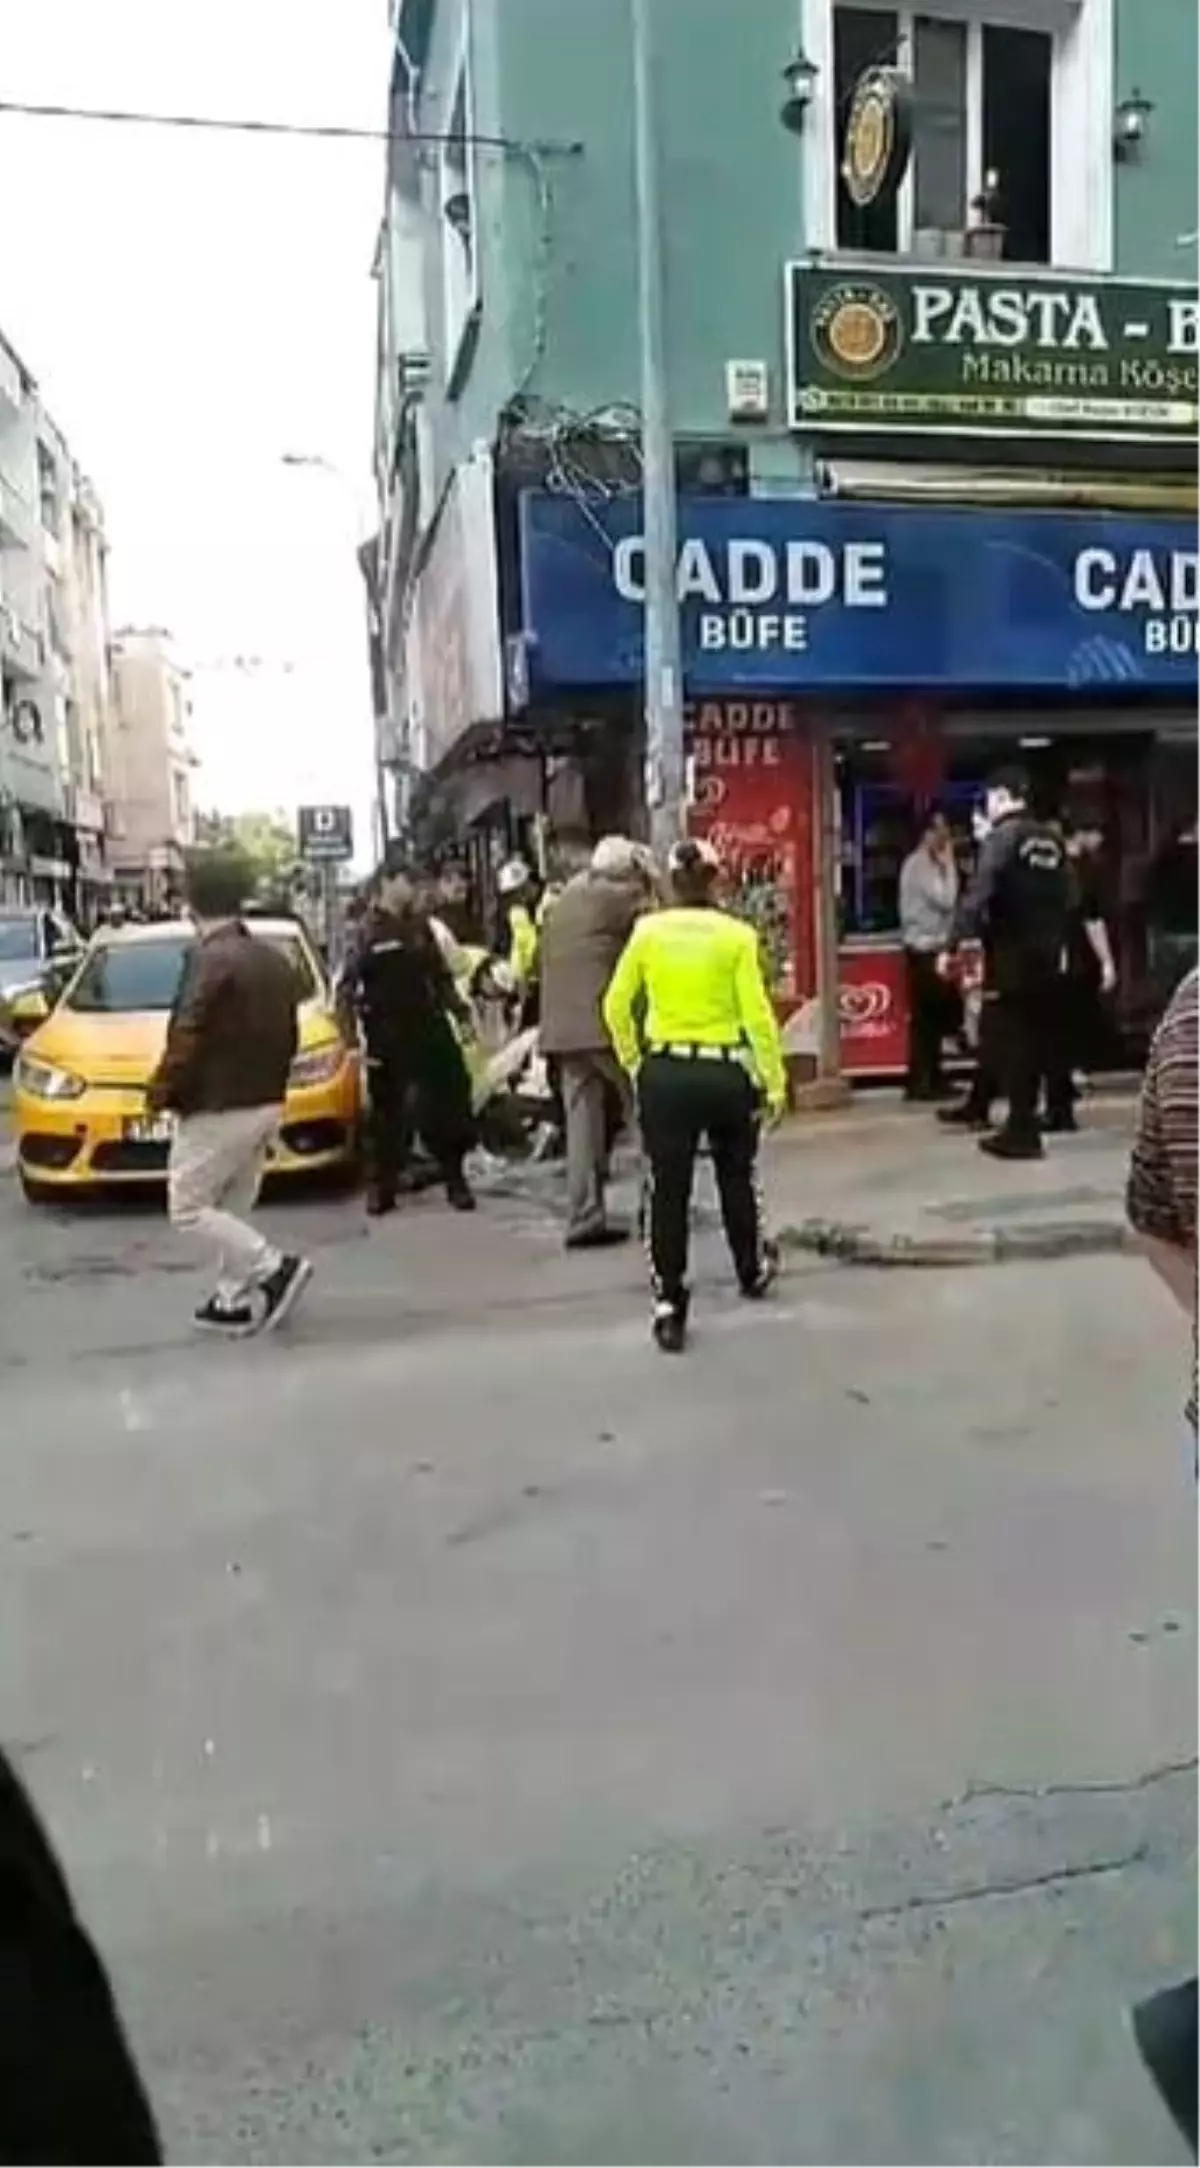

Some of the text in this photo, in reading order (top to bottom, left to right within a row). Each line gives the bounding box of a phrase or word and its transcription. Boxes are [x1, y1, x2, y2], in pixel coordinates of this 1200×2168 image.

[911, 285, 1109, 347] PASTA
[615, 536, 887, 606] CADDE
[701, 608, 807, 648] BÜFE
[1146, 616, 1200, 653] BÜ
